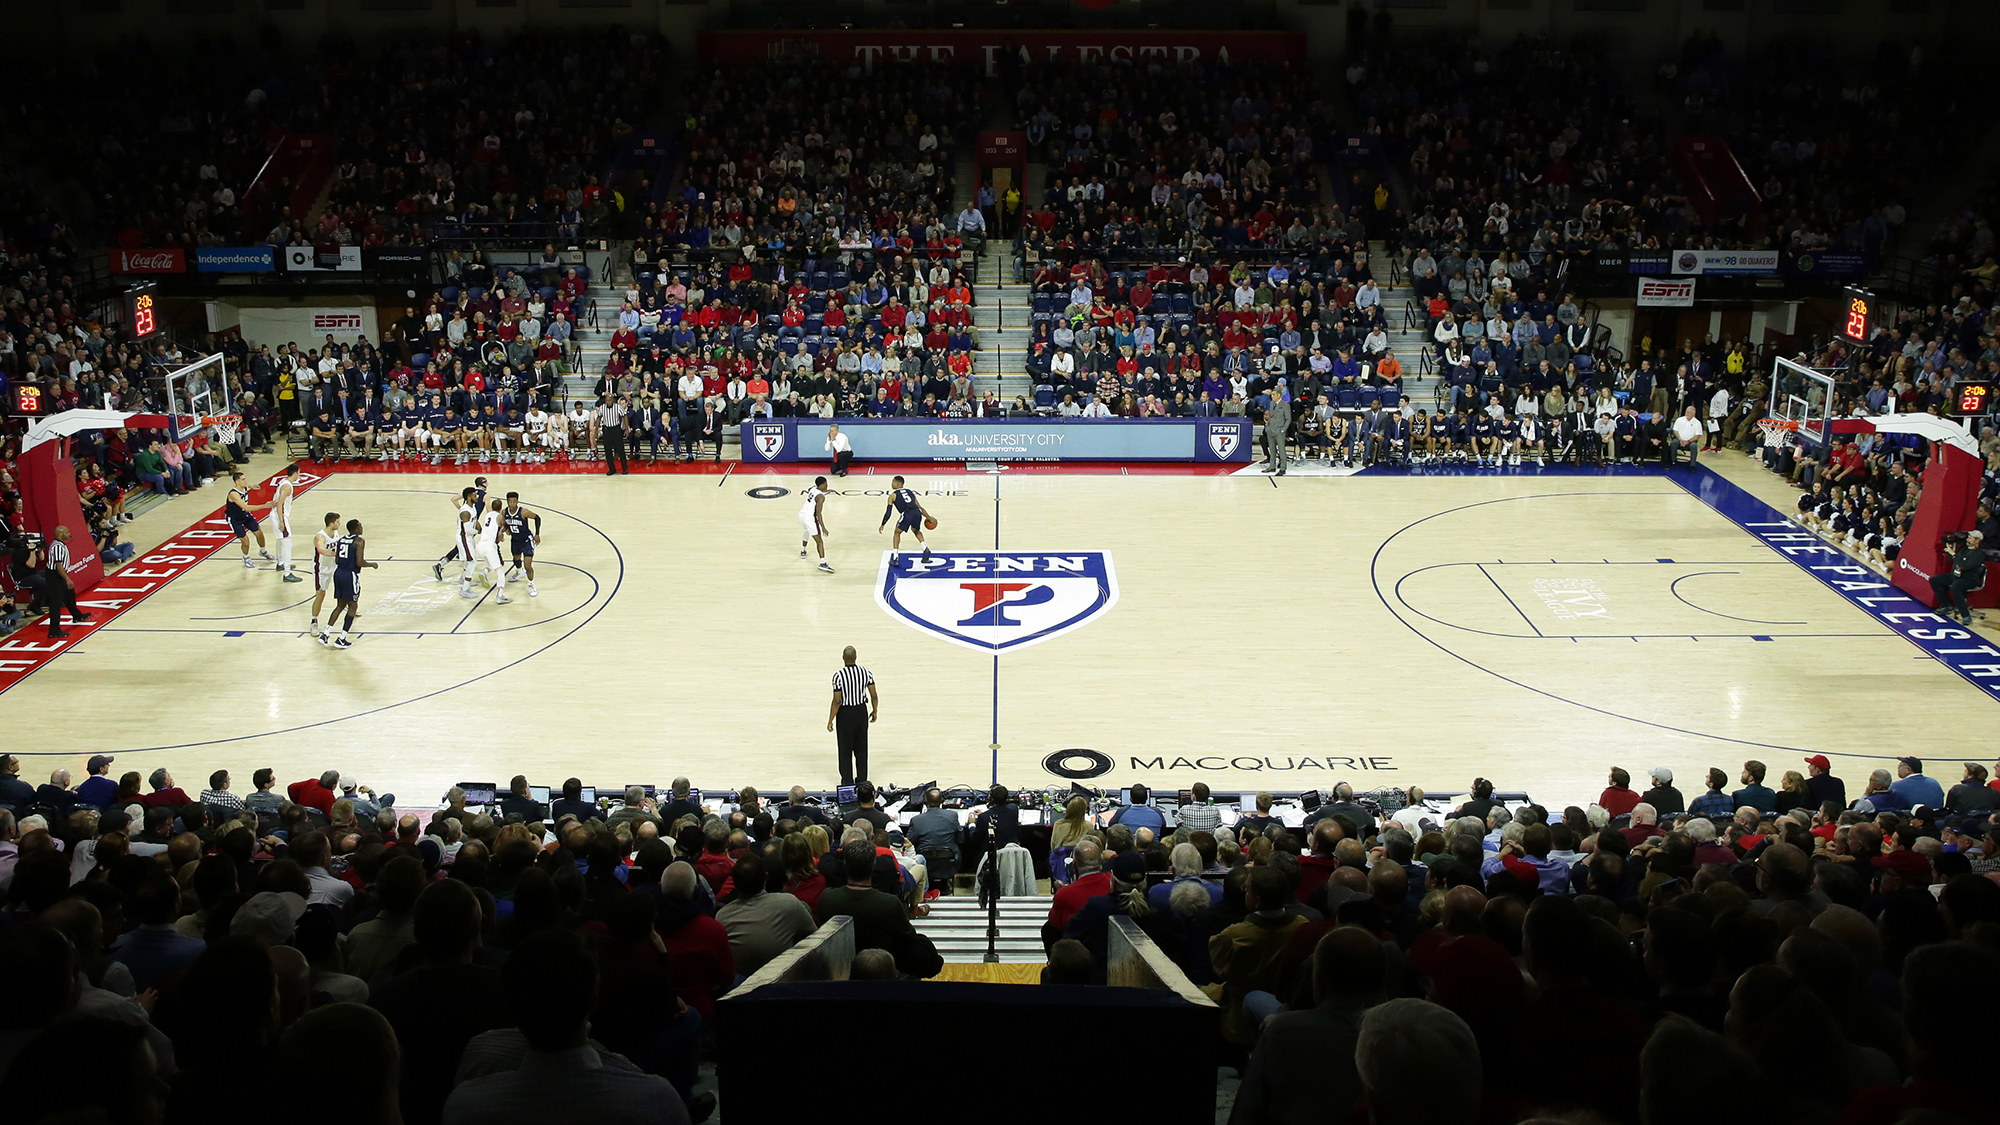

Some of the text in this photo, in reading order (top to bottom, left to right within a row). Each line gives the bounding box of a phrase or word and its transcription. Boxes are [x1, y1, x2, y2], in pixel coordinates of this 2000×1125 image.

[198, 255, 260, 265] Independence
[1642, 283, 1691, 296] ESPN
[137, 294, 153, 309] 2:06
[1851, 298, 1867, 314] 2:06
[136, 308, 155, 336] 23
[315, 315, 360, 327] ESPN
[1847, 311, 1865, 339] 23
[20, 386, 40, 396] 2:06
[1964, 386, 1985, 395] 2:06
[20, 397, 38, 410] 23
[1961, 397, 1979, 410] 23
[965, 434, 1034, 445] UNIVERSITY
[1037, 434, 1065, 445] CITY
[801, 489, 968, 497] ACQRIE
[904, 494, 912, 504] 5
[485, 517, 491, 527] 3
[339, 544, 349, 558] 21
[906, 557, 1088, 572] PENN
[1907, 563, 1931, 581] MACQUARIE
[1533, 589, 1576, 620] LEAGUE
[1552, 589, 1616, 620] IVY
[1745, 521, 2000, 692] THE PALEST
[0, 640, 68, 672] HE
[1130, 756, 1398, 771] MACQUARIE
